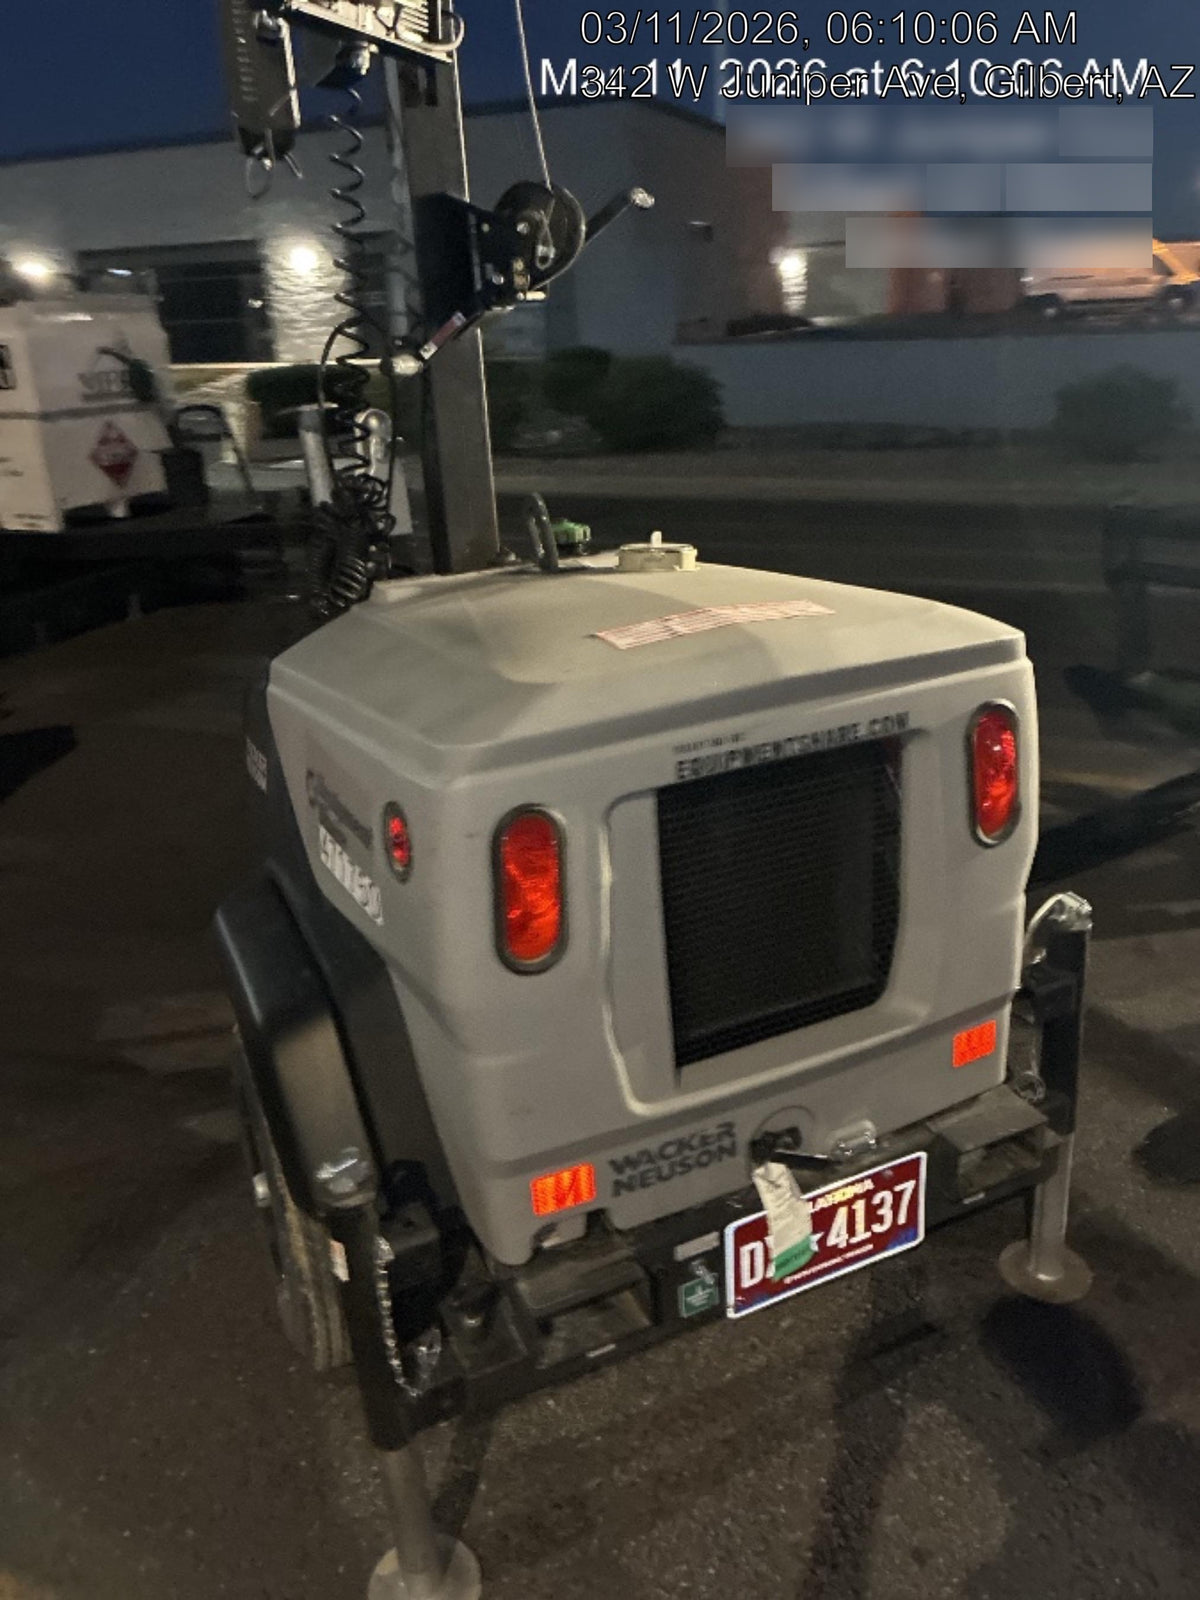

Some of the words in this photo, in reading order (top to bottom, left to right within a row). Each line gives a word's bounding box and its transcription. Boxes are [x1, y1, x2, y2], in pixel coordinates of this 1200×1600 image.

[608, 1121, 736, 1174] WACKER
[611, 1138, 736, 1198] NEUSON
[826, 1180, 917, 1250] 4137
